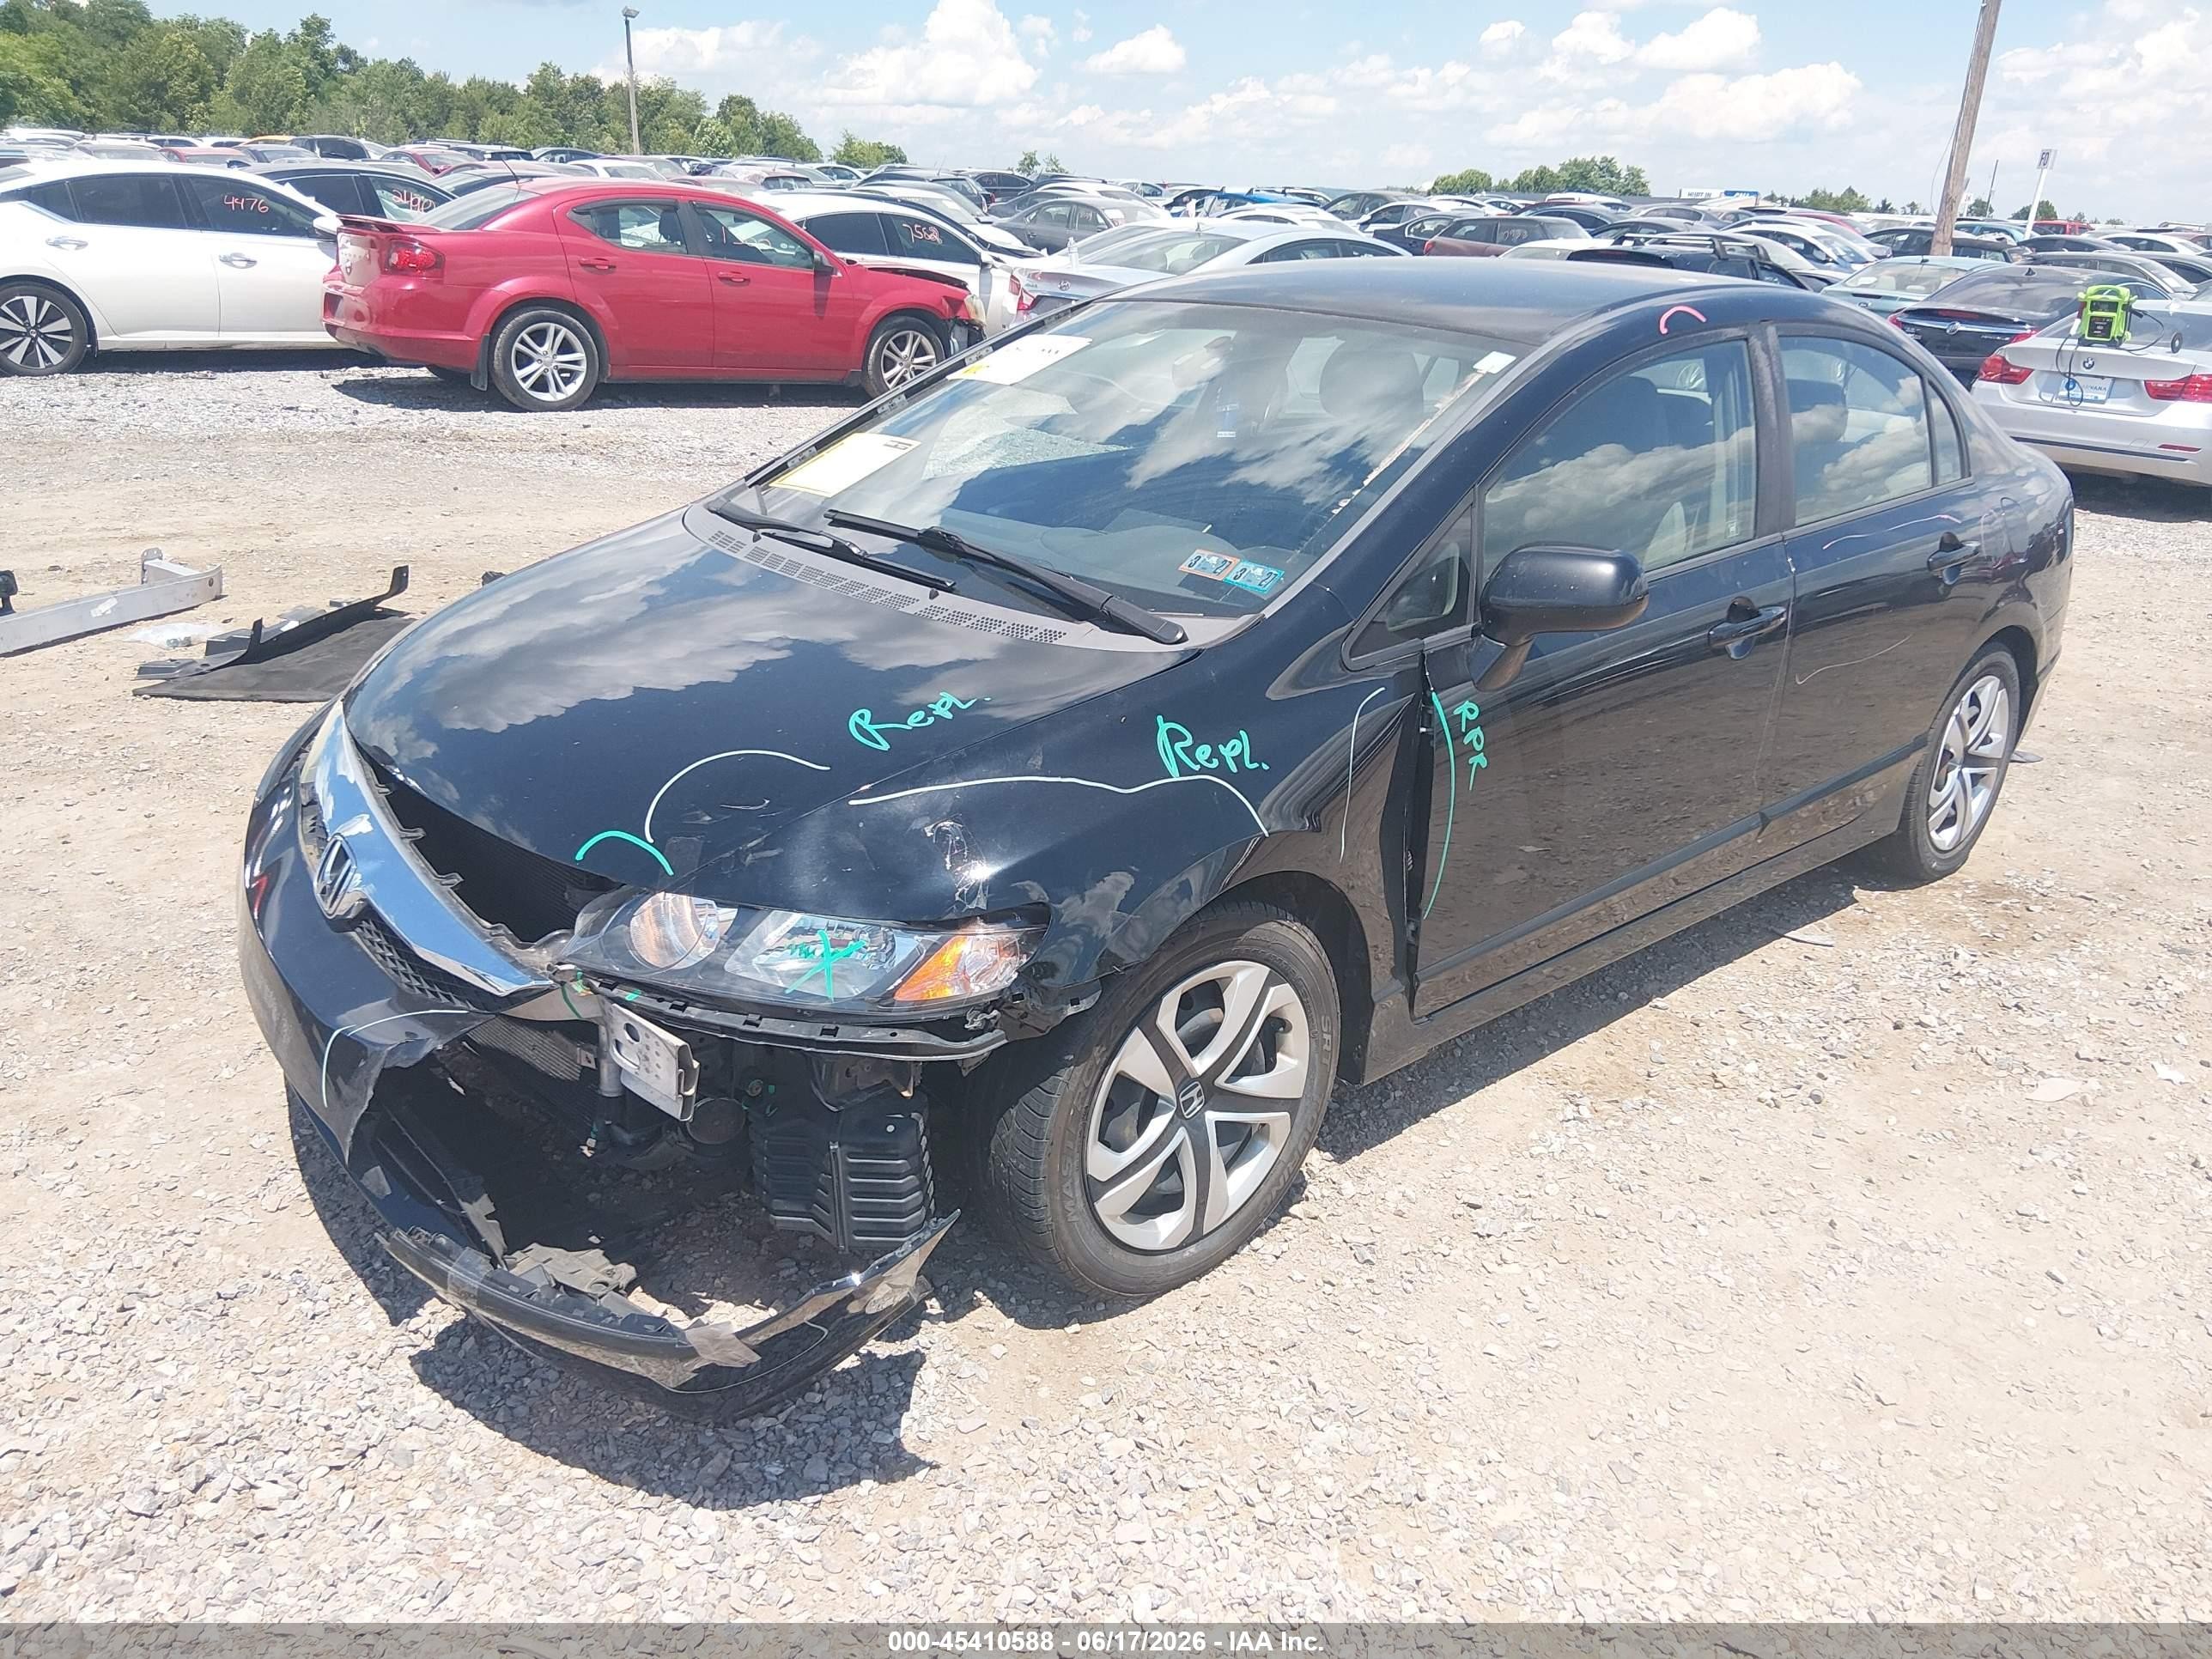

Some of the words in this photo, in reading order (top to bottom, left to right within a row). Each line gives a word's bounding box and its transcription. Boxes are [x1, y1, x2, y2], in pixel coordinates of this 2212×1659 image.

[223, 194, 270, 213] 4476
[1188, 555, 1202, 568] 3
[1212, 559, 1233, 576] 27
[1233, 567, 1248, 580] 3
[1258, 571, 1279, 588] 27
[1320, 1015, 1332, 1073] SRT
